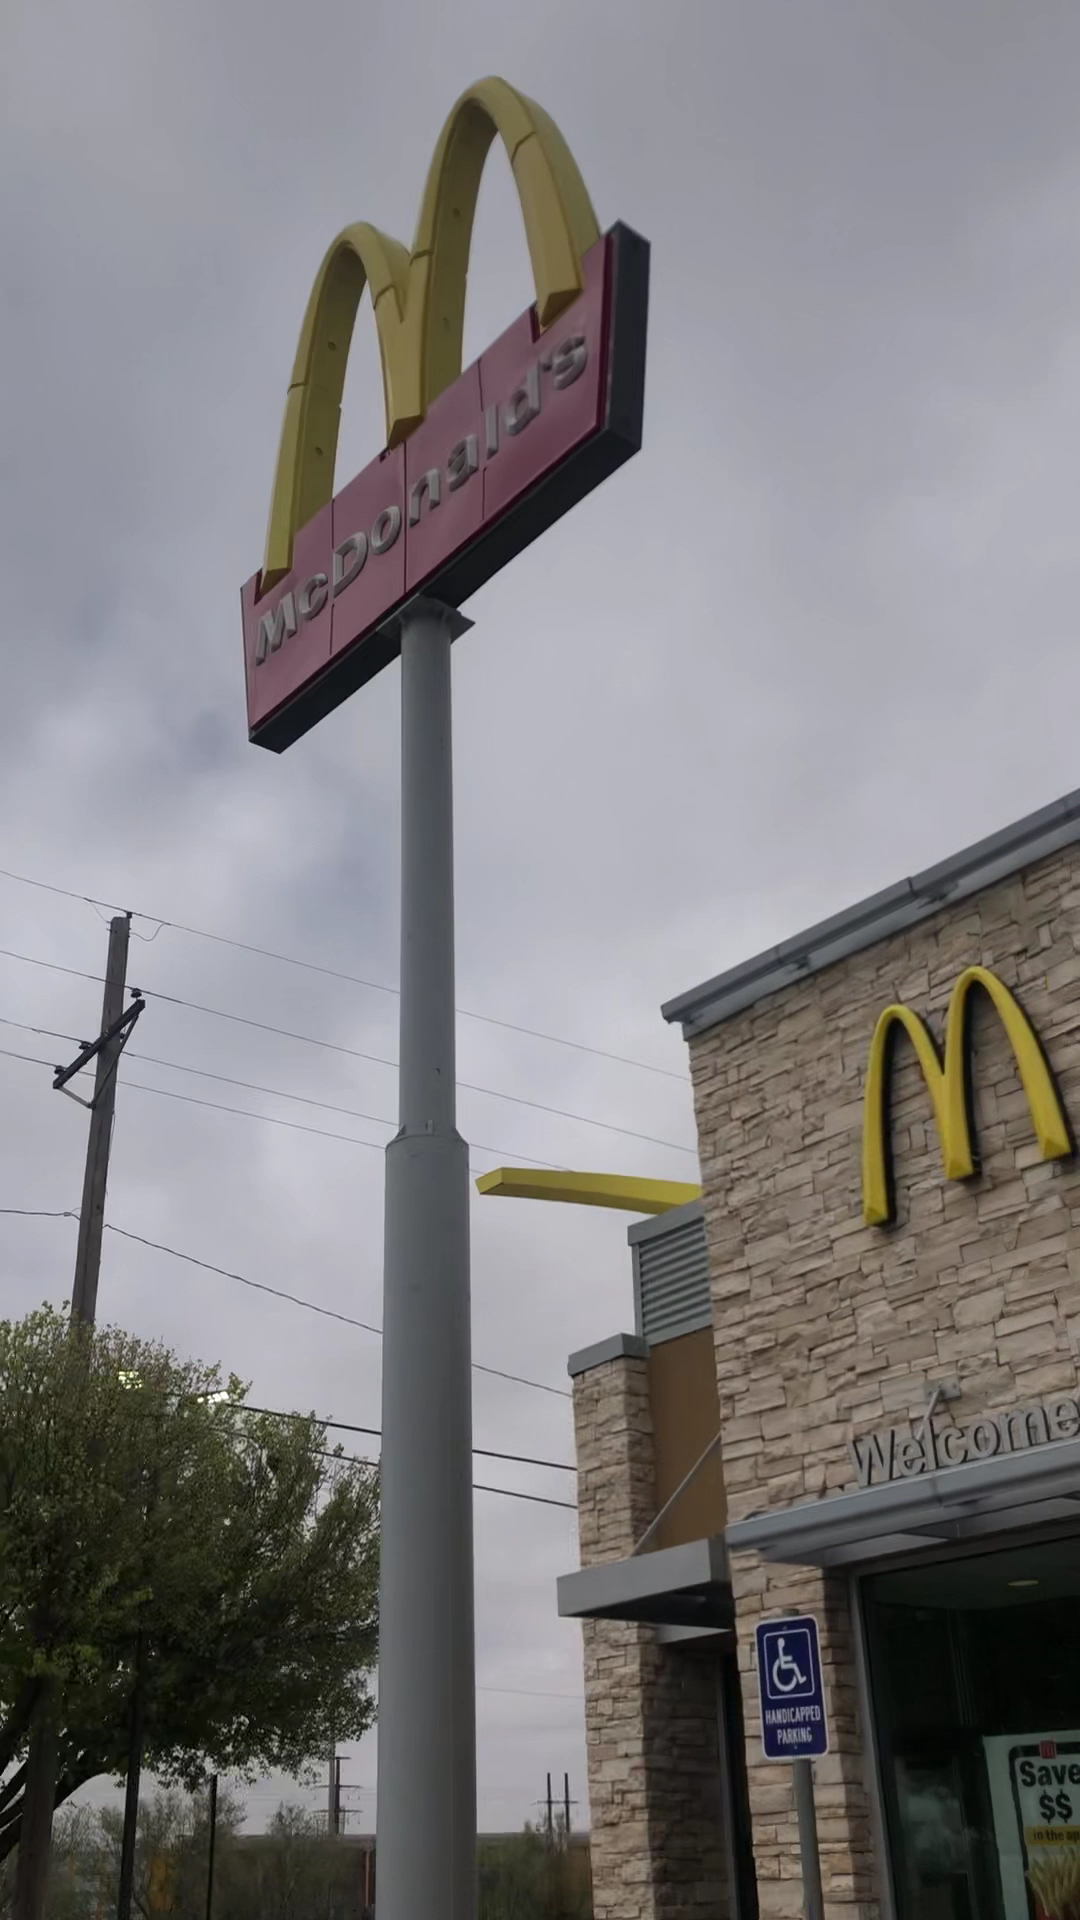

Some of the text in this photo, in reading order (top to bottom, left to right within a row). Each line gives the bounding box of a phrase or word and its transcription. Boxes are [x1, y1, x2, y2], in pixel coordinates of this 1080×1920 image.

[255, 333, 588, 667] McDonald's
[848, 1397, 1080, 1488] Welcome
[765, 1705, 821, 1725] HANDICAPPED
[777, 1727, 812, 1745] PARKING
[1019, 1760, 1080, 1788] Save
[1039, 1789, 1073, 1825] $$
[1033, 1828, 1044, 1841] in
[1046, 1828, 1065, 1841] the
